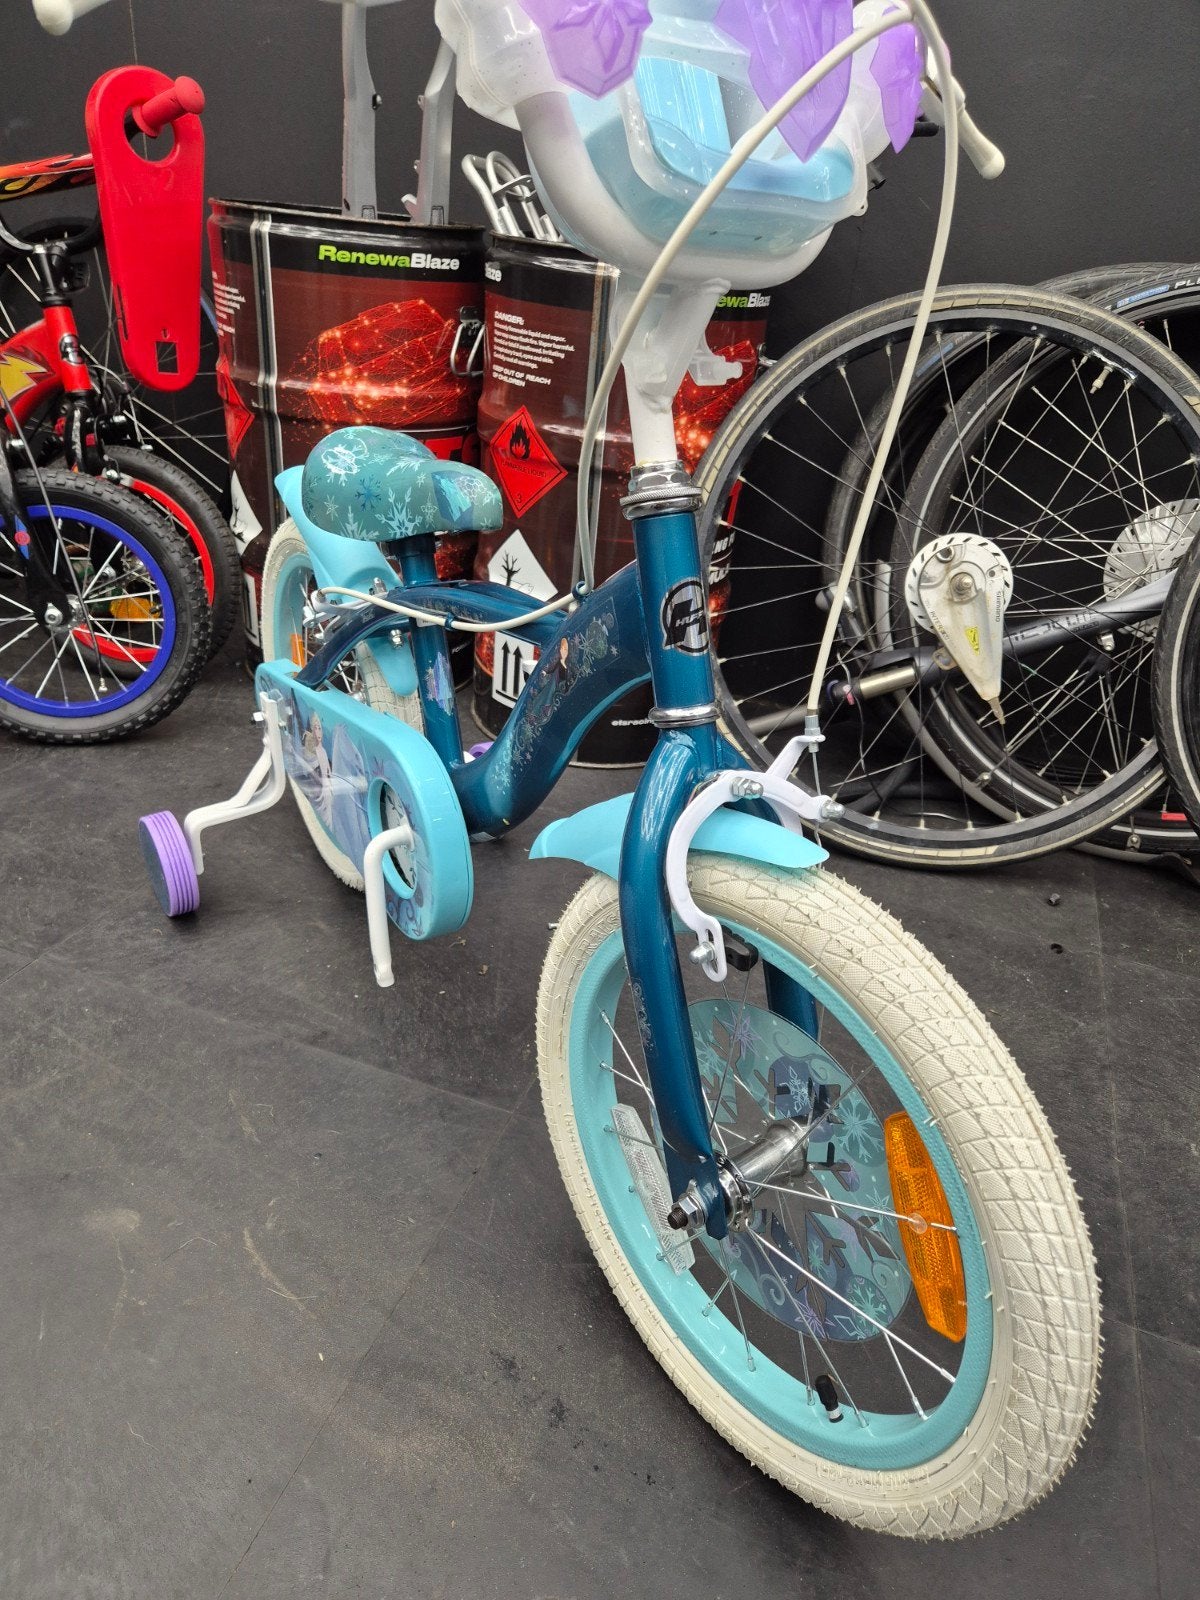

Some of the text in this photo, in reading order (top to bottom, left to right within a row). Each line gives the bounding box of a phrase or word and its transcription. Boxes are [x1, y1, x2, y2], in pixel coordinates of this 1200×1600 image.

[318, 244, 460, 271] RenewaBlaze
[498, 373, 525, 387] CHILDREN
[503, 368, 515, 376] OUT
[525, 374, 551, 385] REACH
[515, 493, 522, 504] 3
